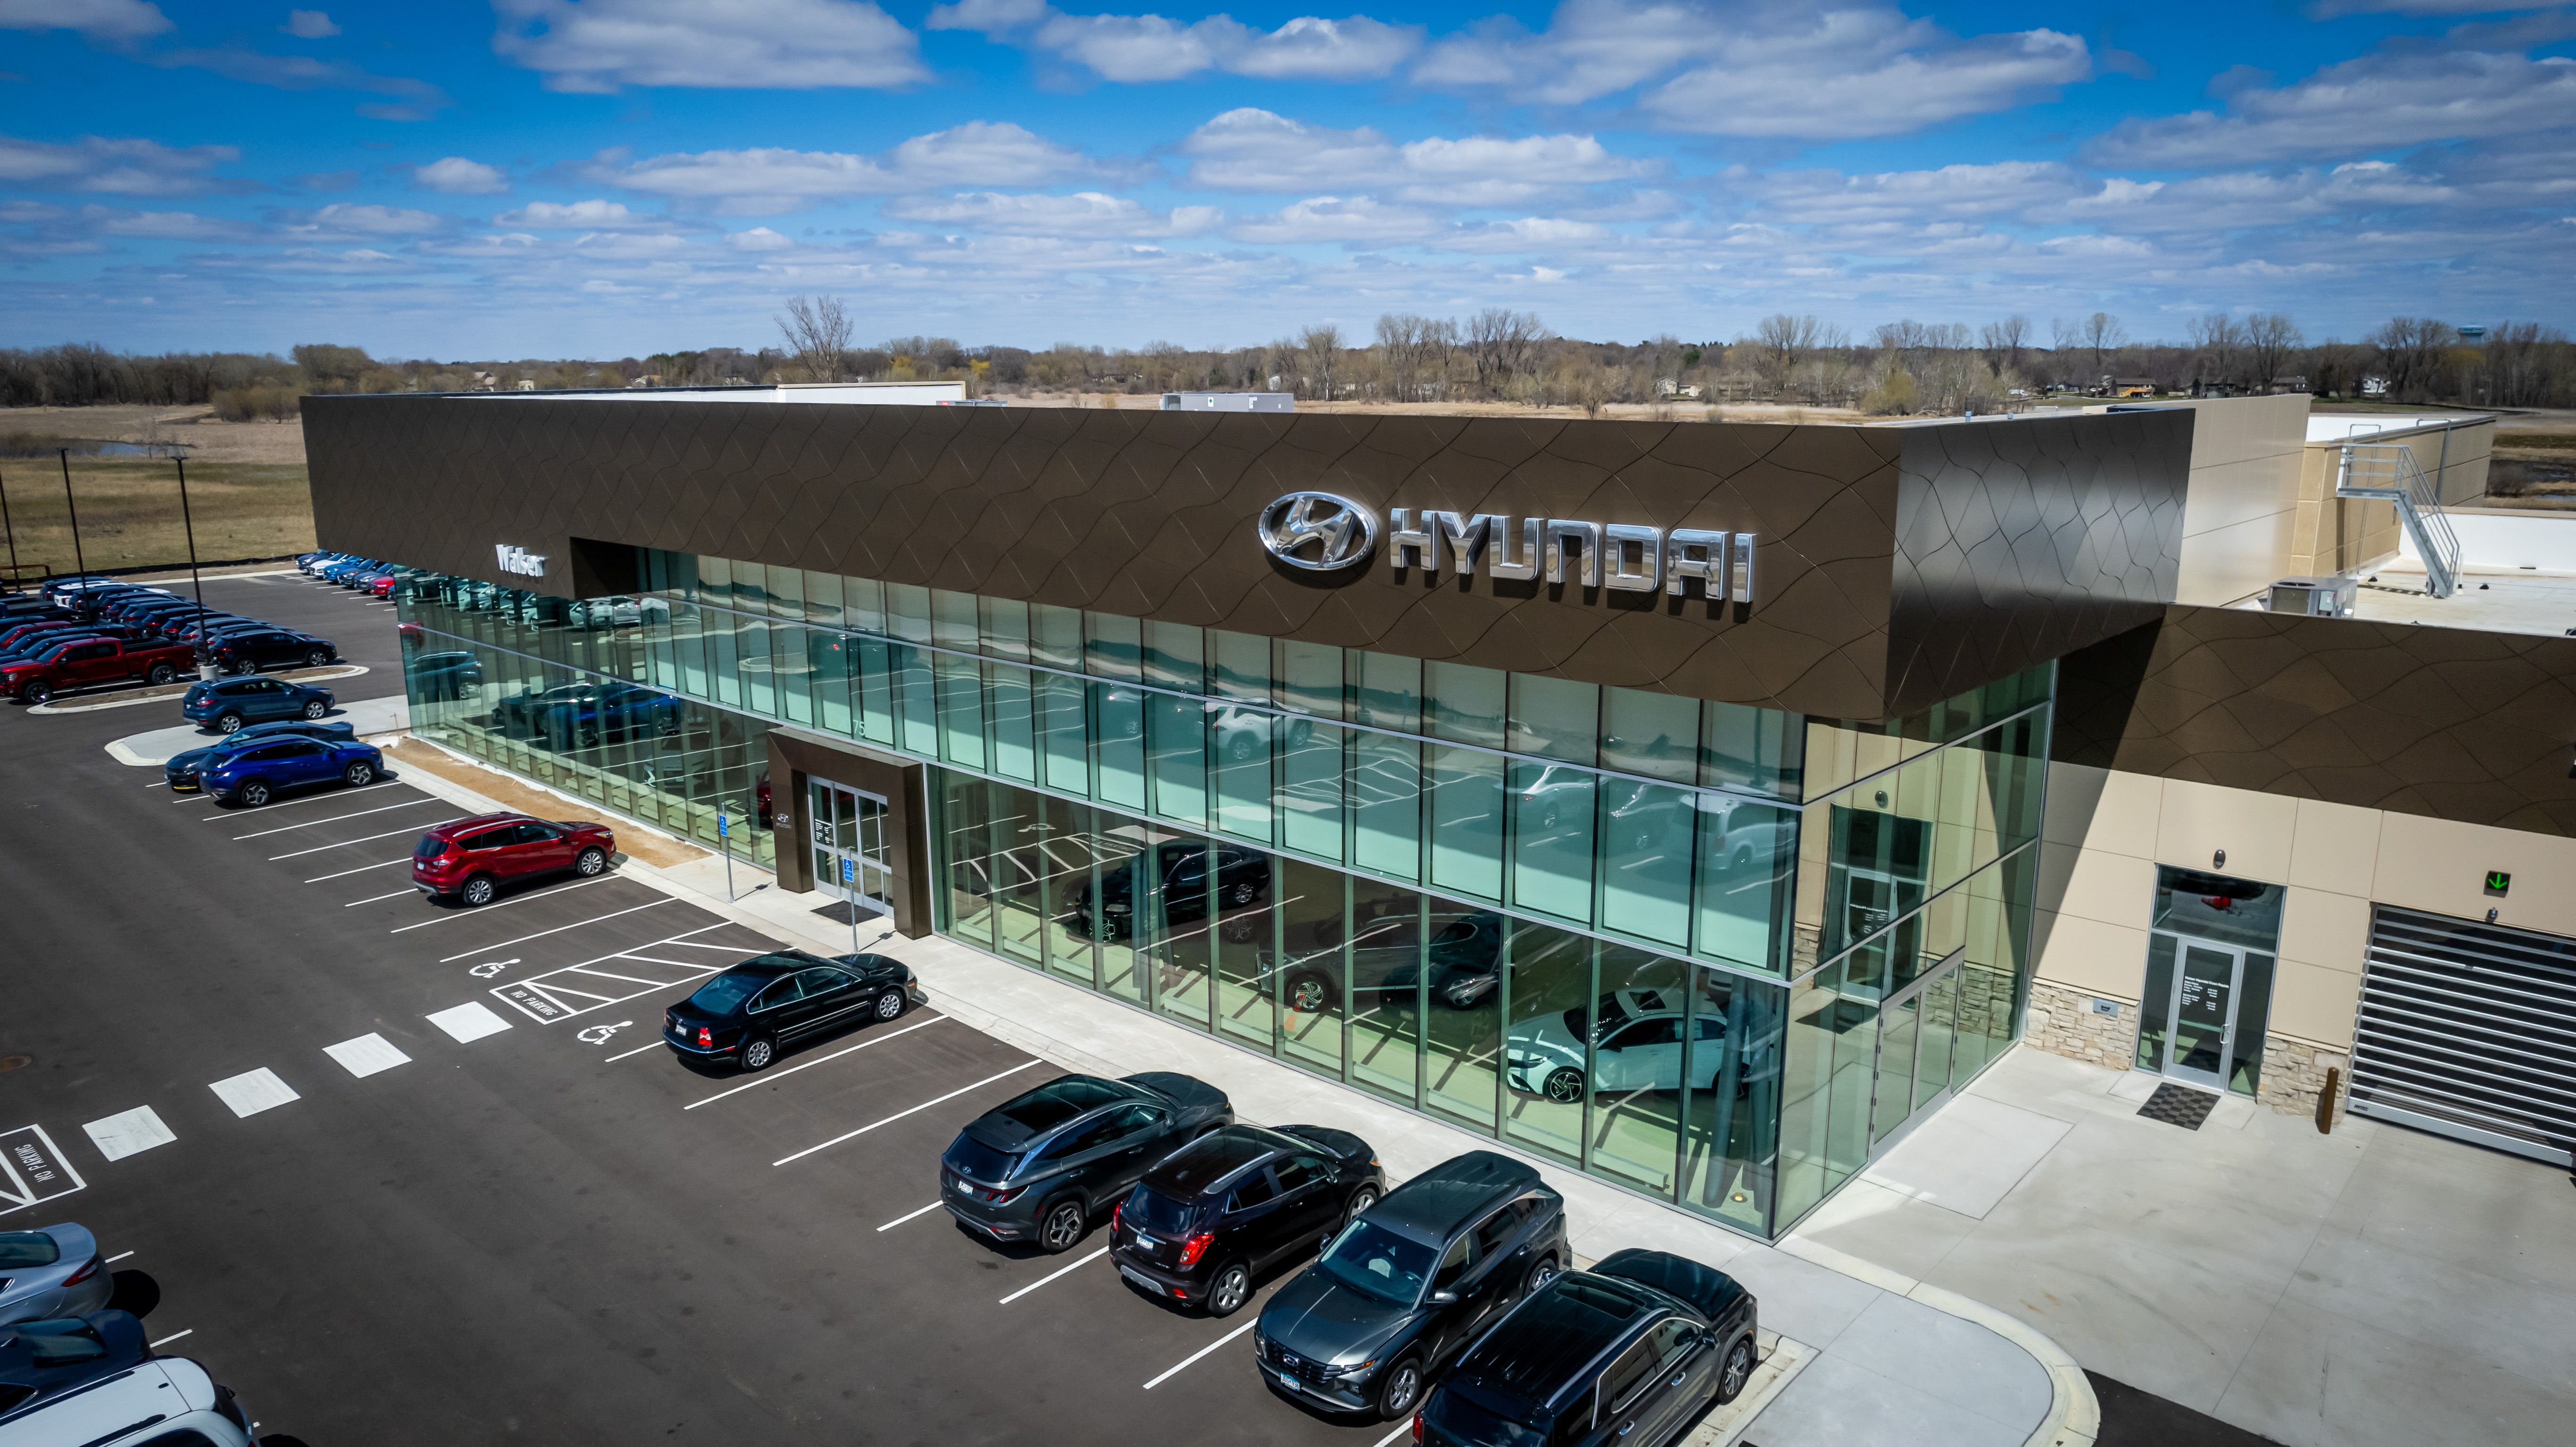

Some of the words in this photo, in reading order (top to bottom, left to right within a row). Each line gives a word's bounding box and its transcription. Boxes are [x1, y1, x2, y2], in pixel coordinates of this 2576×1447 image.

[495, 544, 546, 577] Walser
[1390, 508, 1756, 603] HYUNDAI
[510, 990, 528, 998] NO
[522, 997, 558, 1016] PARKING
[15, 1144, 47, 1171] PARKING
[34, 1170, 56, 1183] NO
